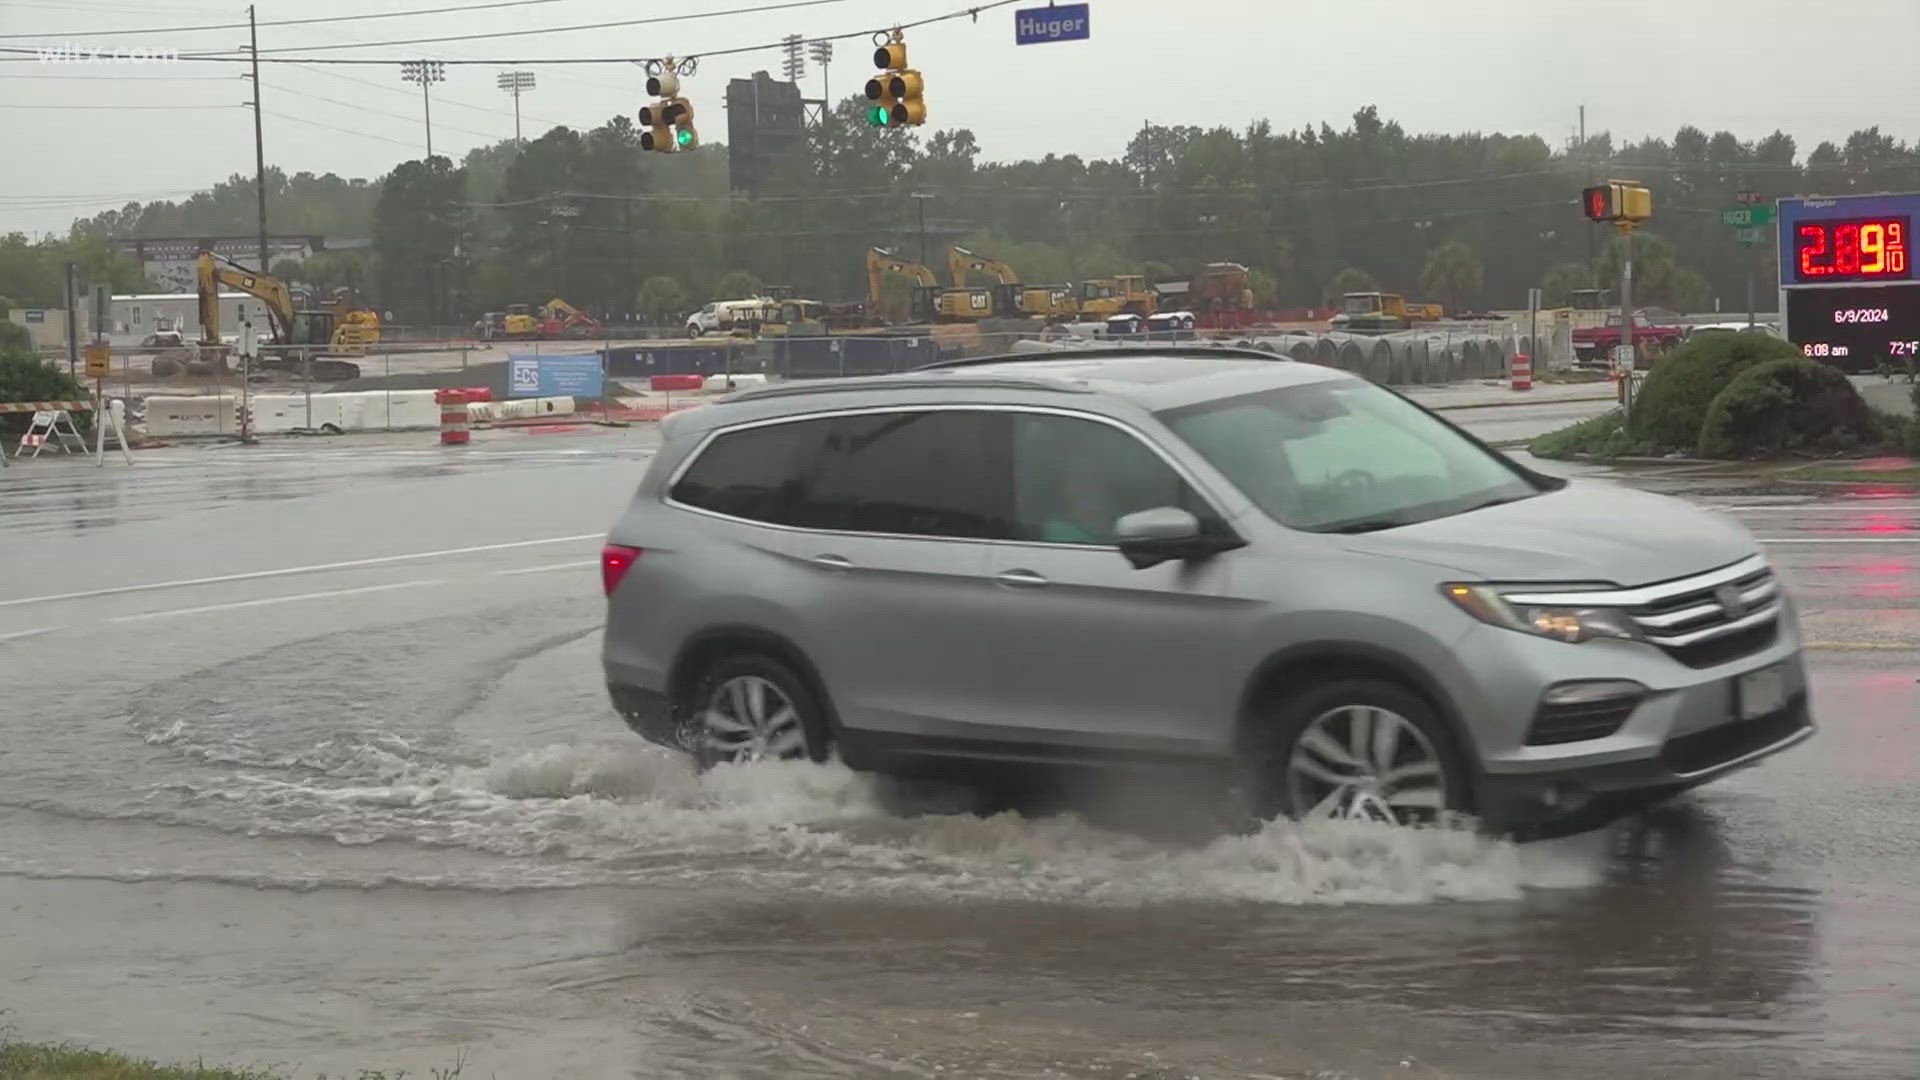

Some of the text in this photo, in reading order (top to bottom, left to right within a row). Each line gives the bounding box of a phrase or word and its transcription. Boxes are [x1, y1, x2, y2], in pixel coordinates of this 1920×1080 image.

[1019, 18, 1084, 37] Huger
[1803, 199, 1836, 209] Regular
[1723, 210, 1751, 225] HUGER
[971, 295, 986, 308] CAT
[1834, 309, 1889, 323] 6/9/2024
[1804, 343, 1829, 356] 6:08
[1831, 346, 1848, 356] am
[514, 366, 538, 386] ECS
